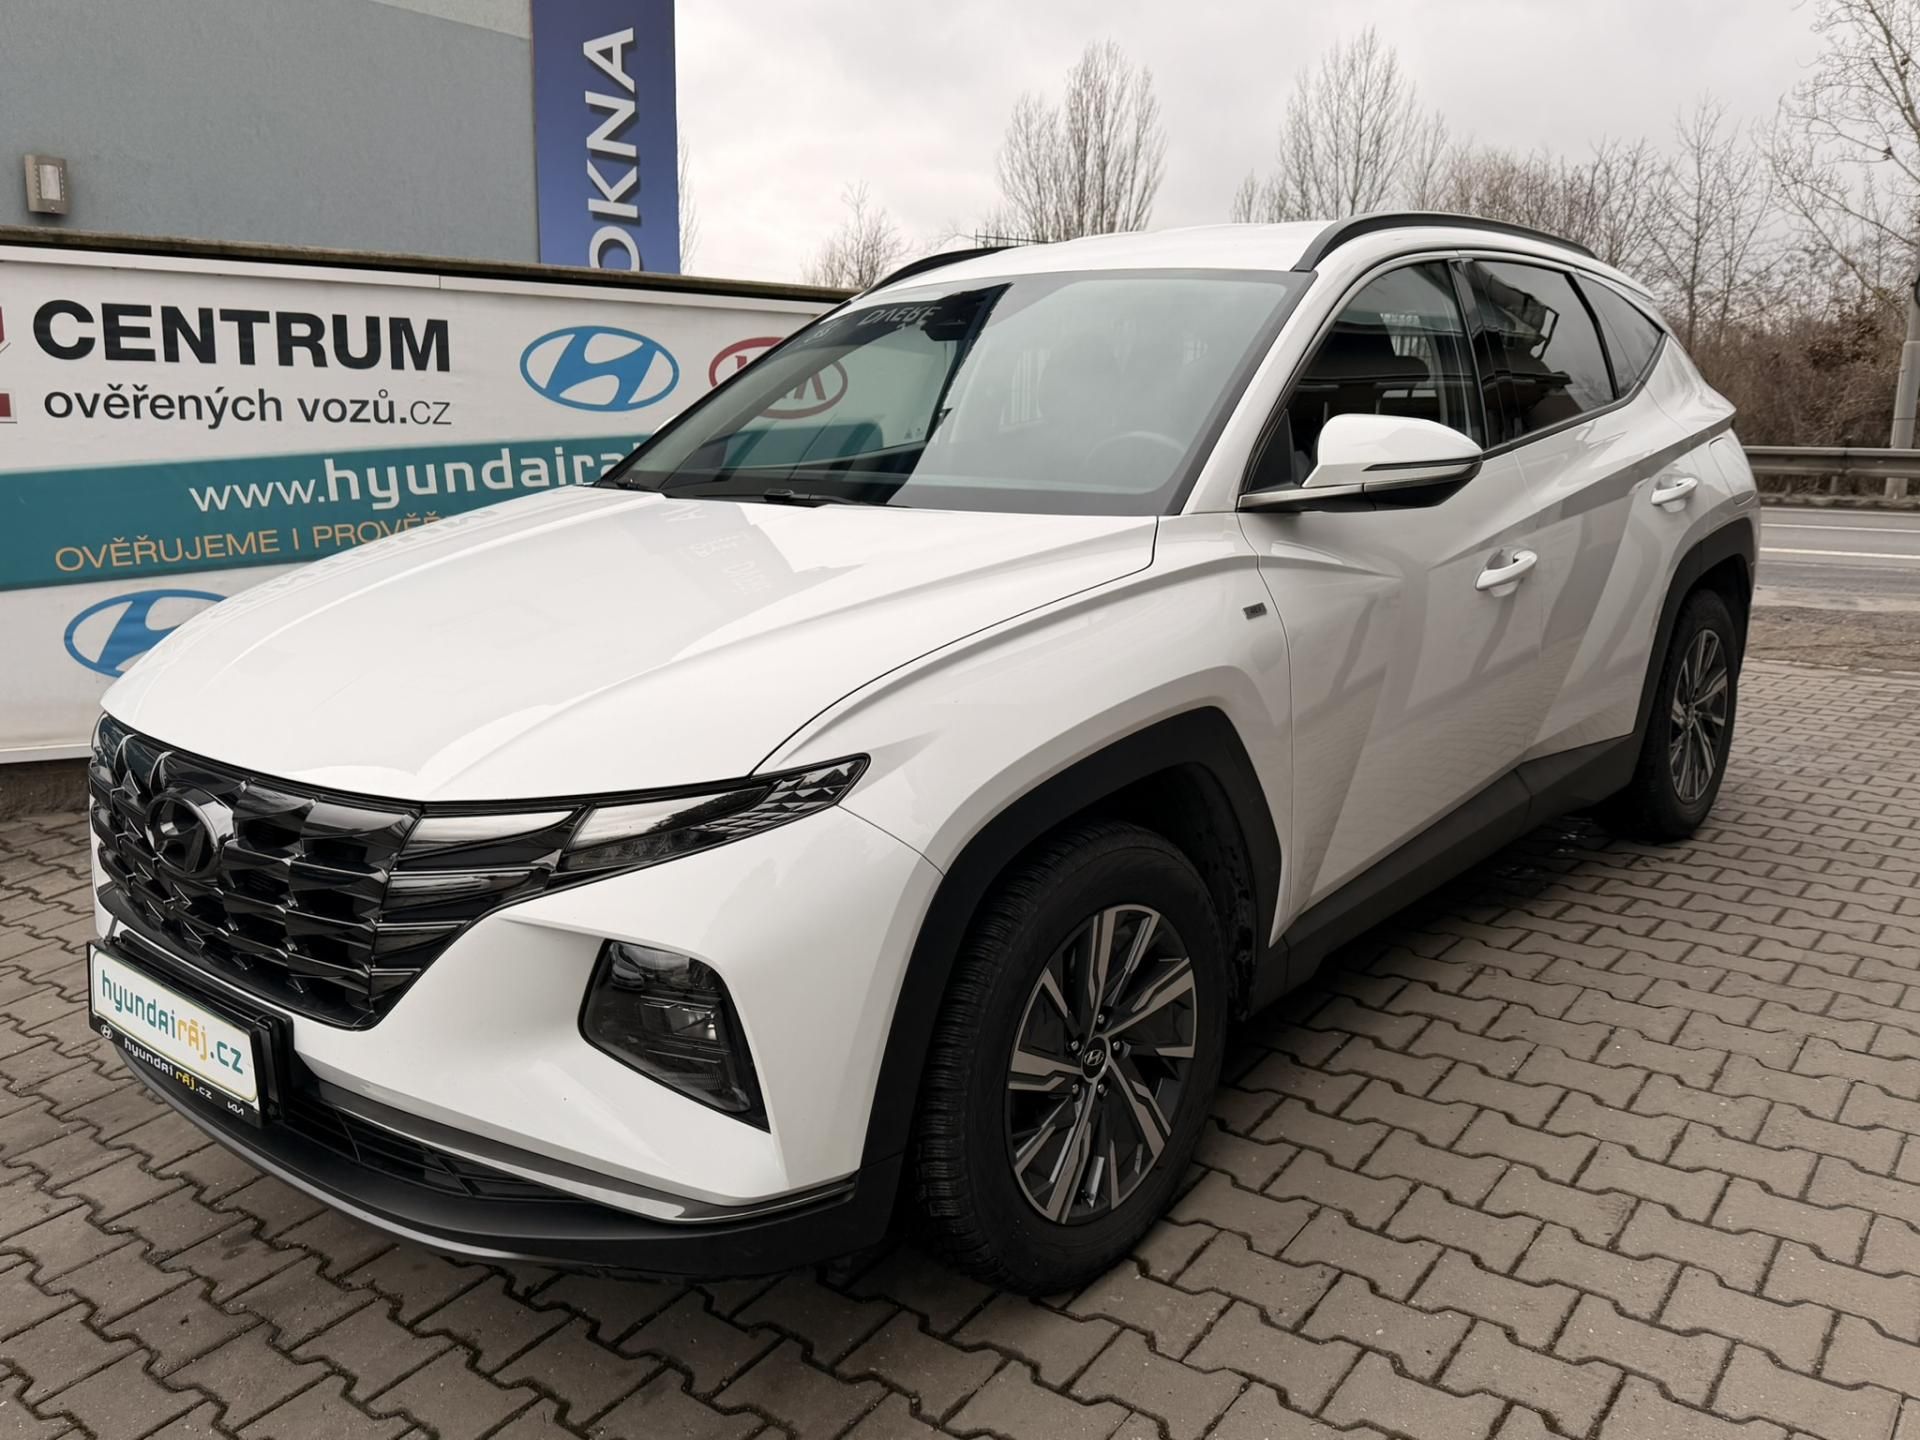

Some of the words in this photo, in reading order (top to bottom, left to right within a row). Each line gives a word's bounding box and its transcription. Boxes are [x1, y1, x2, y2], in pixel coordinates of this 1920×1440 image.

[583, 27, 641, 272] OKNA
[33, 299, 451, 372] CENTRUM
[44, 383, 283, 429] ověřených
[189, 442, 640, 512] www.hyundaira
[55, 529, 281, 571] OVĚŘUJEME
